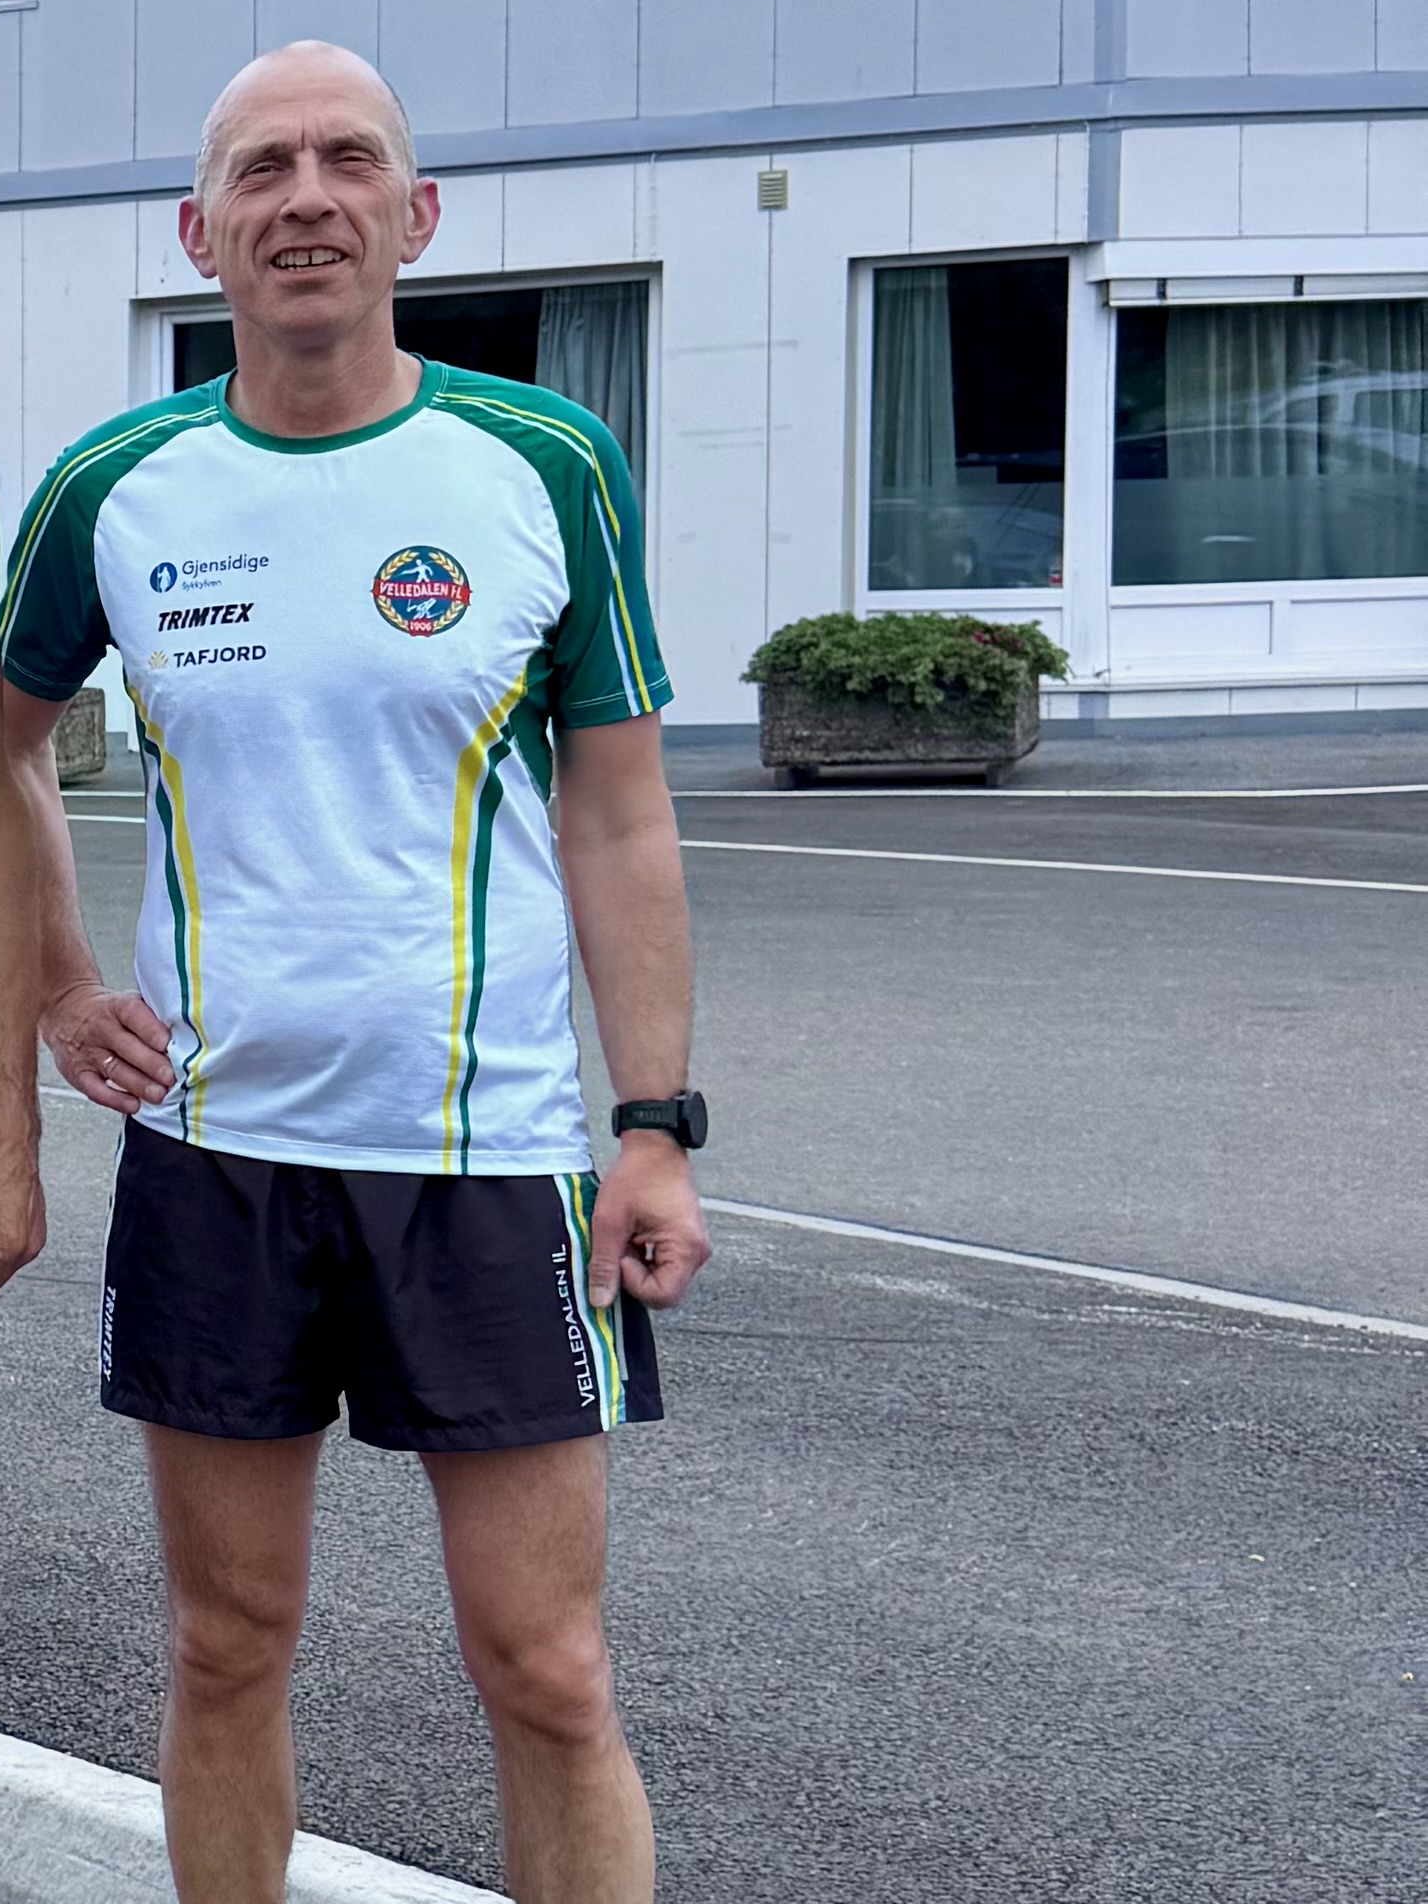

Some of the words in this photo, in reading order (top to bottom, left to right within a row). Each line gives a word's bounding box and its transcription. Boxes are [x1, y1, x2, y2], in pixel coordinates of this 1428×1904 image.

[182, 553, 270, 579] Gjensidige
[379, 582, 448, 597] VELLEDALEN
[158, 603, 255, 632] TRIMTEX
[409, 621, 432, 632] 1906
[173, 645, 267, 668] TAFJORD
[551, 1244, 567, 1263] IL
[556, 1270, 596, 1407] VELLEDALEN
